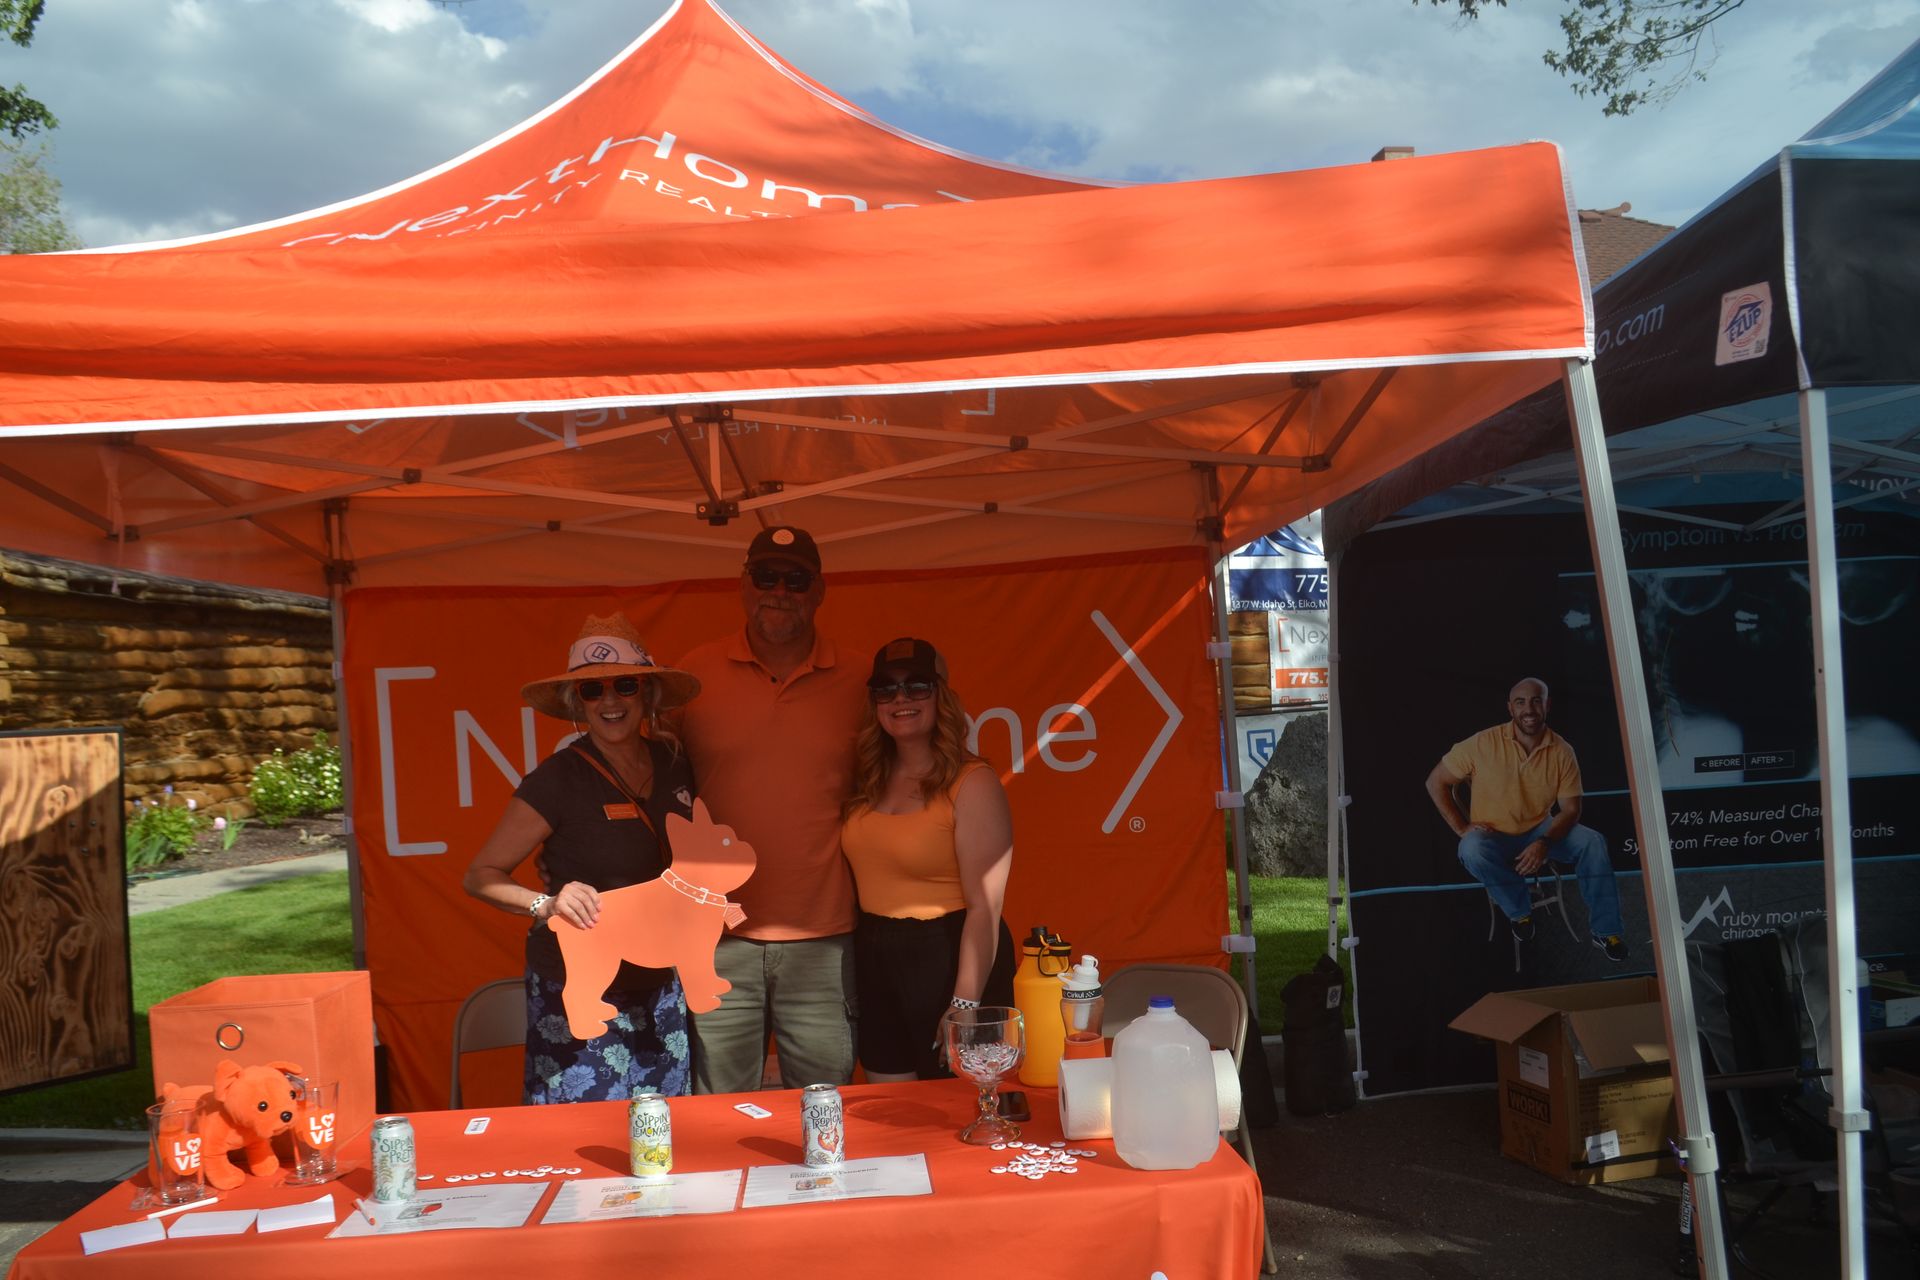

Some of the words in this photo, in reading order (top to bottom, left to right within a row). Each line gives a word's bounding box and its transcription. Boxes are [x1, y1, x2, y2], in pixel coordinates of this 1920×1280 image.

[326, 131, 920, 245] NextHom
[618, 168, 793, 219] REALT
[1768, 522, 1865, 543] Proem
[1262, 600, 1285, 609] Idaho
[1709, 758, 1740, 767] BEFORE
[1751, 756, 1776, 765] AFTER
[1671, 810, 1704, 826] 74%
[1709, 804, 1785, 824] Measured
[1791, 803, 1823, 819] Cha
[1623, 836, 1698, 855] Sytom
[1703, 834, 1739, 848] Free
[1743, 831, 1765, 847] for
[1770, 829, 1808, 845] Over
[1850, 822, 1895, 840] onths
[1722, 911, 1761, 928] ruby
